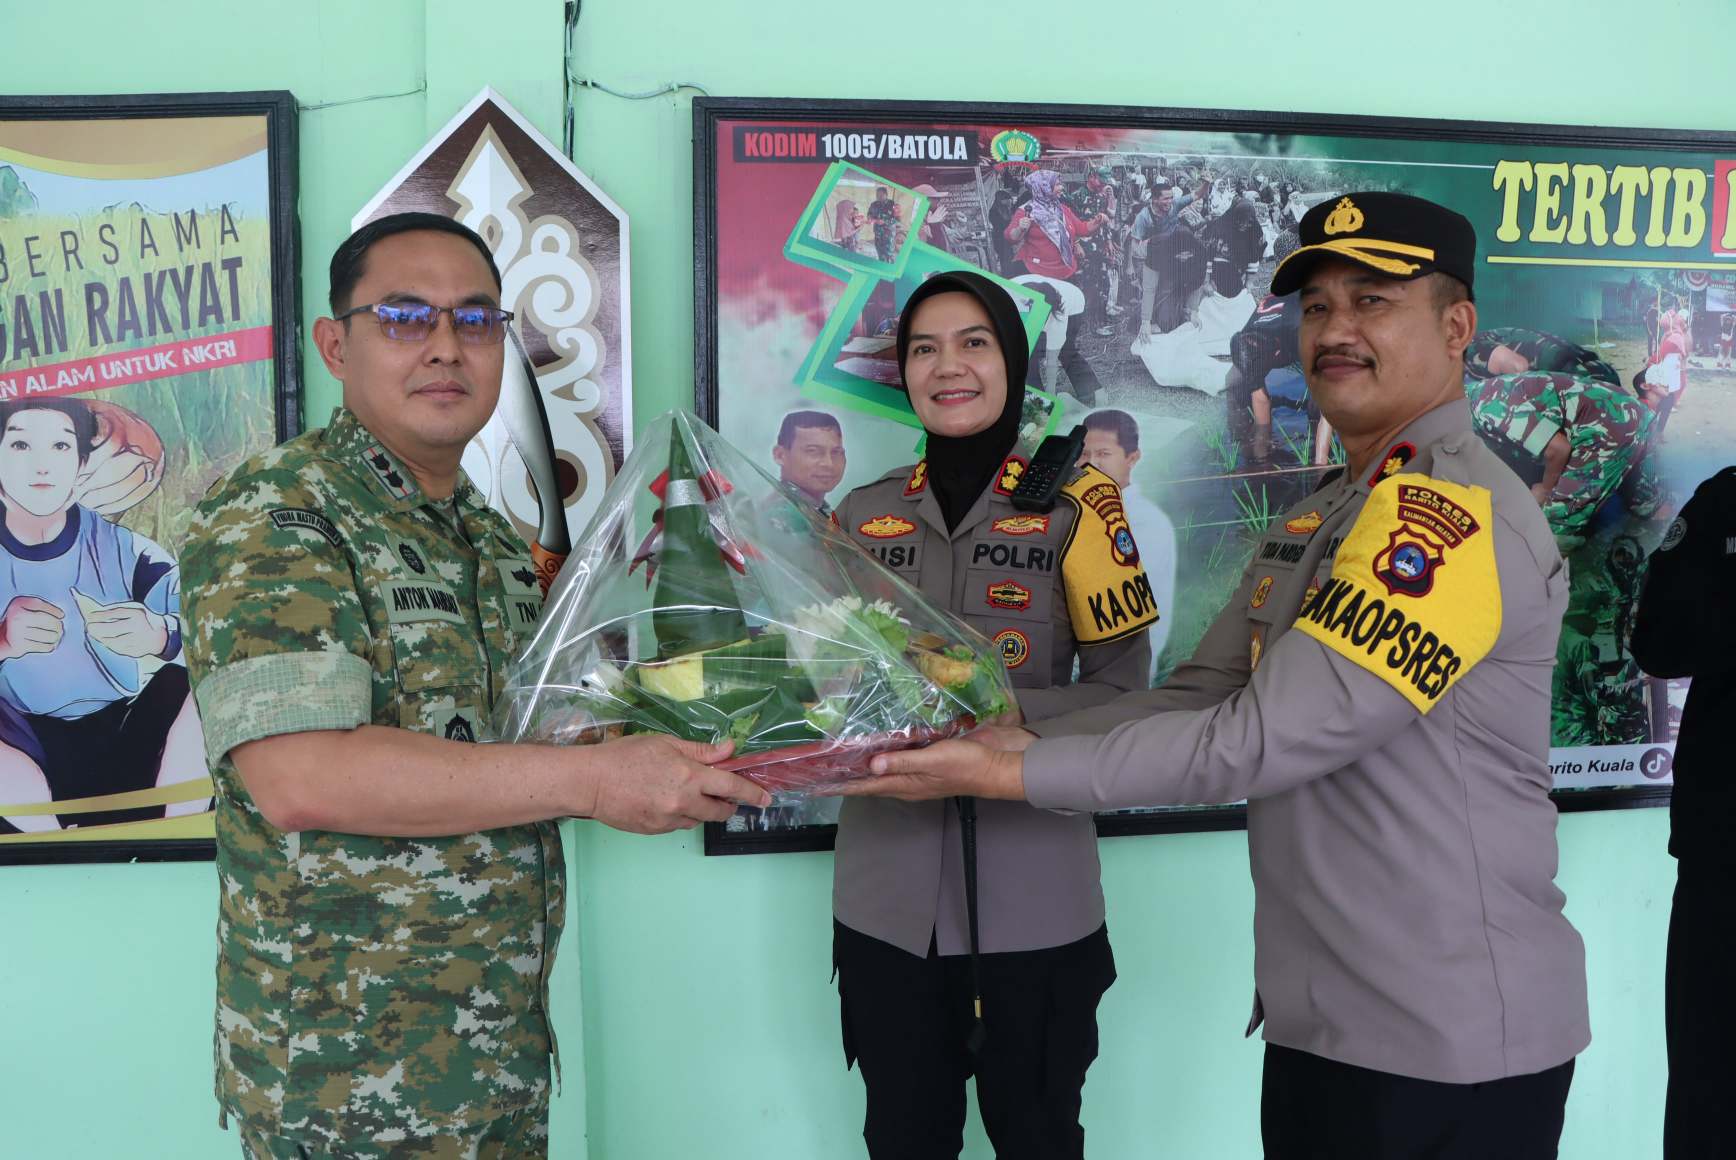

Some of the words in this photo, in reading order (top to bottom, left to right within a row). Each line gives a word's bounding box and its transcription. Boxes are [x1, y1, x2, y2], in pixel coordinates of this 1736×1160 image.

[745, 132, 817, 158] KODIM
[821, 133, 968, 160] 1005/BATOLA
[1492, 160, 1707, 248] TERTIB
[84, 256, 243, 348] RAKYAT
[26, 365, 96, 395] ALAM
[100, 350, 178, 380] UNTUK
[182, 339, 238, 366] NKRI
[1407, 488, 1472, 526] POLRES
[973, 543, 1054, 572] POLRI
[1587, 758, 1635, 774] Kuala
